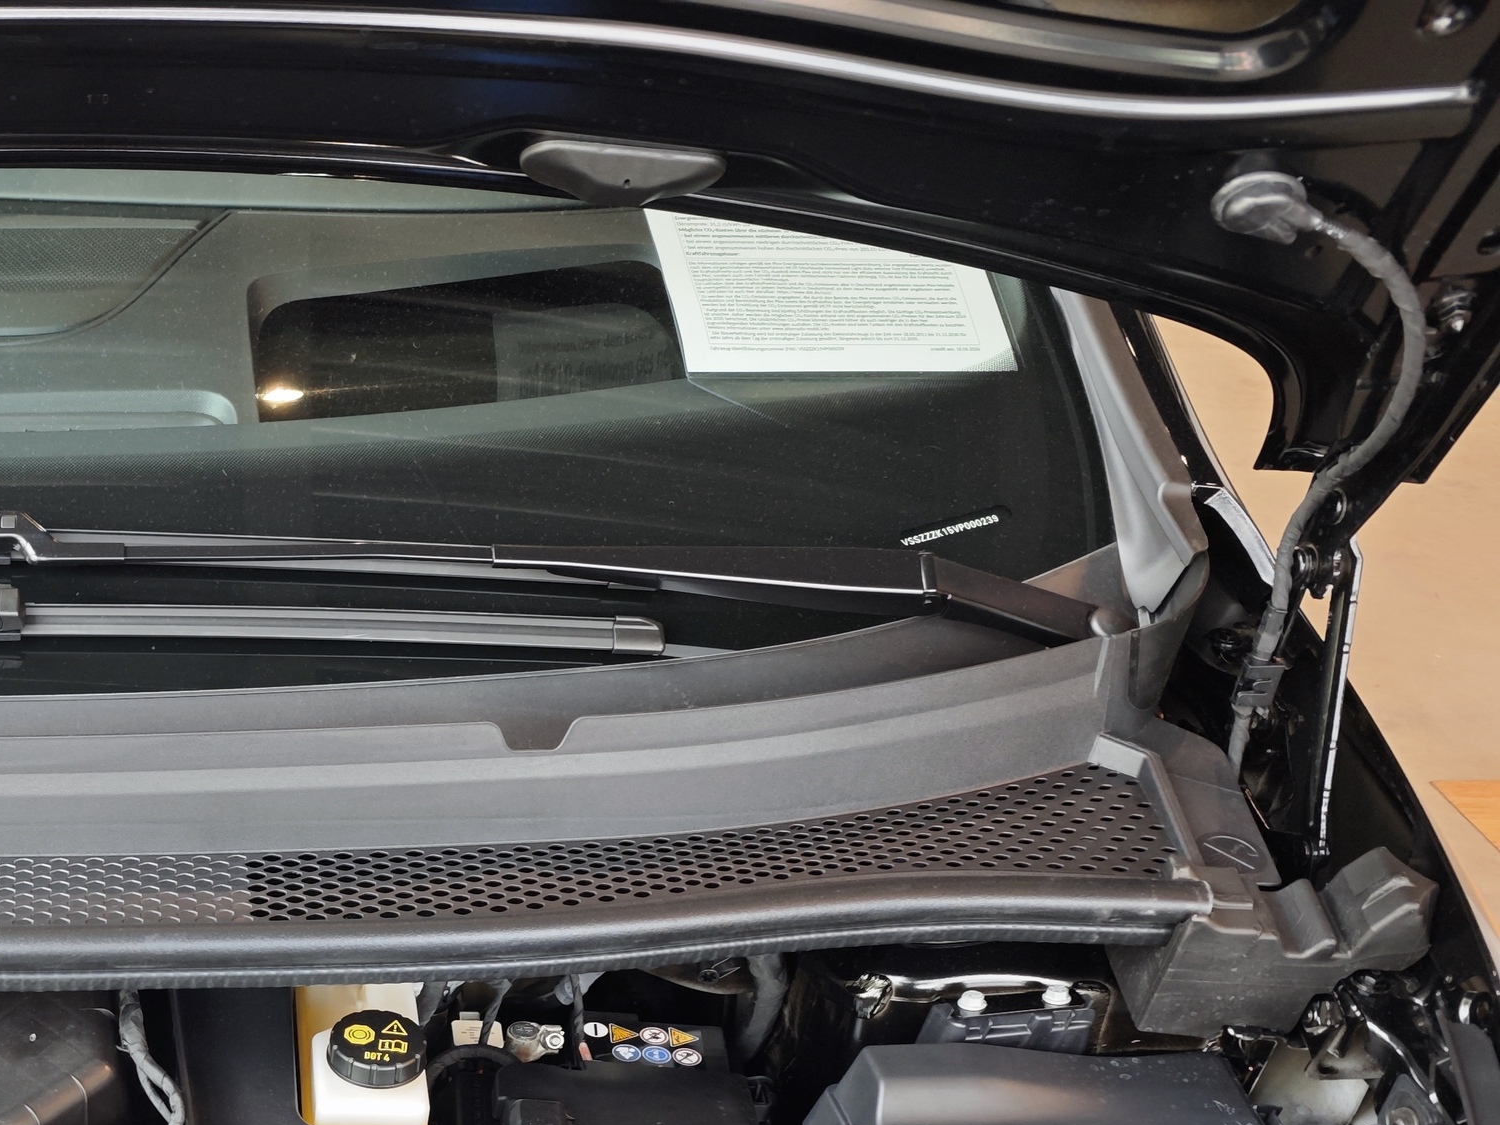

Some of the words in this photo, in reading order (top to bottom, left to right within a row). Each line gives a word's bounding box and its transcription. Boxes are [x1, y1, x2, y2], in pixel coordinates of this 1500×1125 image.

[900, 514, 999, 547] VSSZZZK15VP000239
[364, 1051, 382, 1060] DOT
[384, 1053, 390, 1062] 4
